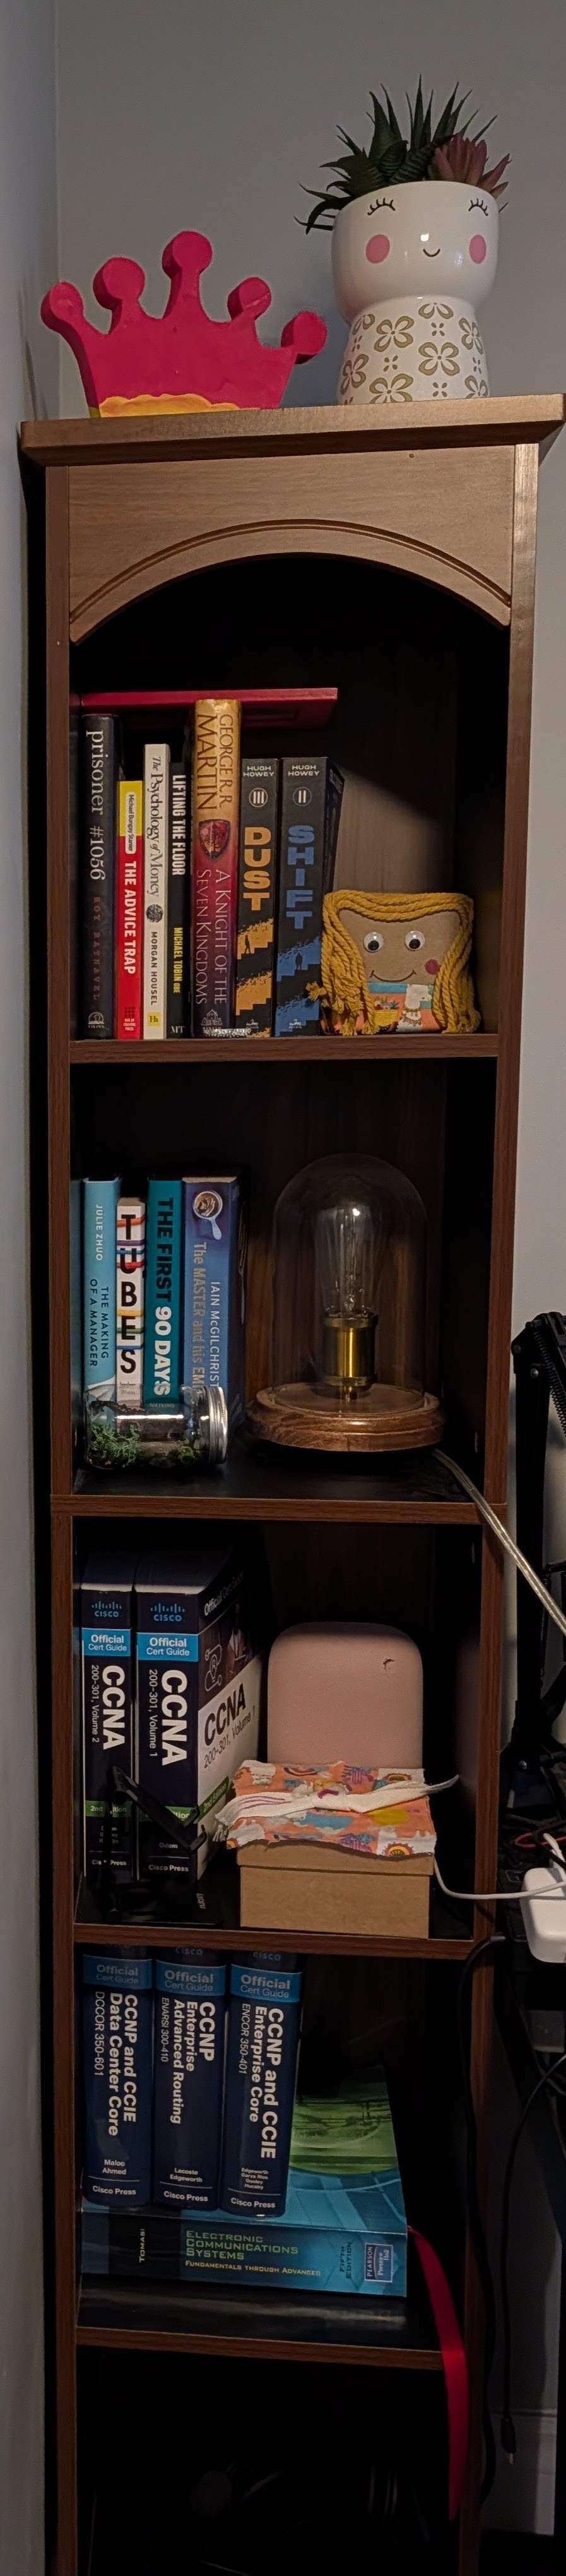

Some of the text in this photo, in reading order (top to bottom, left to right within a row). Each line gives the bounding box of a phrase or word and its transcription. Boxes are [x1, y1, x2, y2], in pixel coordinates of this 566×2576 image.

[152, 756, 161, 770] The
[197, 713, 218, 809] MARTIN
[219, 714, 233, 808] GEORGE R. R.
[86, 730, 109, 880] prisoner #1056
[146, 773, 163, 843] Psychology
[172, 775, 186, 876] LIFTING THE FLOOR
[146, 853, 163, 897] Money
[242, 826, 271, 911] DUST
[286, 825, 315, 929] SHIFT
[124, 861, 136, 974] THE ADVICE TRAP
[196, 869, 211, 1005] SEVEN KINGDOMS
[214, 869, 232, 1005] A KNIGHT OF THE
[93, 897, 101, 1000] ROY RATNAVEL
[174, 927, 184, 958] MICHAEL
[173, 960, 183, 982] TOBIN
[193, 1242, 207, 1265] The
[90, 1279, 98, 1294] OF
[120, 1213, 138, 1374] TUBES
[153, 1197, 174, 1396] THE FIRST 90 DAYS
[192, 1268, 206, 1317] MASTER
[90, 1310, 98, 1366] MANAGER
[101, 1312, 109, 1359] MAKING
[192, 1320, 205, 1344] and
[209, 1282, 221, 1388] IAIN McGILCHRIST
[192, 1346, 205, 1364] his
[91, 1634, 124, 1643] Official
[146, 1647, 190, 1656] Cert Guide
[150, 1637, 187, 1647] Official
[91, 1664, 99, 1703] 200-301,
[148, 1669, 158, 1712] 200-301,
[102, 1665, 126, 1750] CCNA
[161, 1669, 187, 1766] CCNA
[204, 1683, 246, 1746] CCNA
[149, 1715, 158, 1749] Volume
[96, 1964, 138, 1976] Official
[96, 1973, 138, 1984] Cert Guide
[164, 1979, 213, 1992] Cert Guide
[165, 1970, 214, 1984] Official
[240, 1974, 290, 1989] Official
[240, 1984, 290, 1998] Cert Guide
[94, 1991, 105, 2076] DCCOR 350-601
[160, 1997, 169, 2063] ENARSI 300-410
[186, 2001, 198, 2072] Enterprise
[198, 2001, 216, 2061] CCNP
[238, 2003, 251, 2075] ENCOR 350-401
[109, 1993, 123, 2137] Data Center Core
[123, 1995, 138, 2123] CCNP and CCIE
[170, 1999, 185, 2125] Advanced Routing
[249, 2006, 268, 2123] Enterprise Core
[261, 2008, 284, 2159] CCNP and CCIE
[92, 2185, 136, 2195] Cisco Press
[102, 2167, 127, 2175] Ahmed
[170, 2174, 203, 2183] Edgeworth
[174, 2167, 198, 2176] Lacoste
[163, 2190, 208, 2202] Cisco Press
[230, 2197, 276, 2209] Cisco Press
[185, 2238, 299, 2255] COMMUNICATIONS
[186, 2230, 264, 2243] ELECTRONIC
[186, 2248, 245, 2260] SYSTEMS
[185, 2260, 321, 2276] FUNDAMENTALS THROUGH ADVANCED
